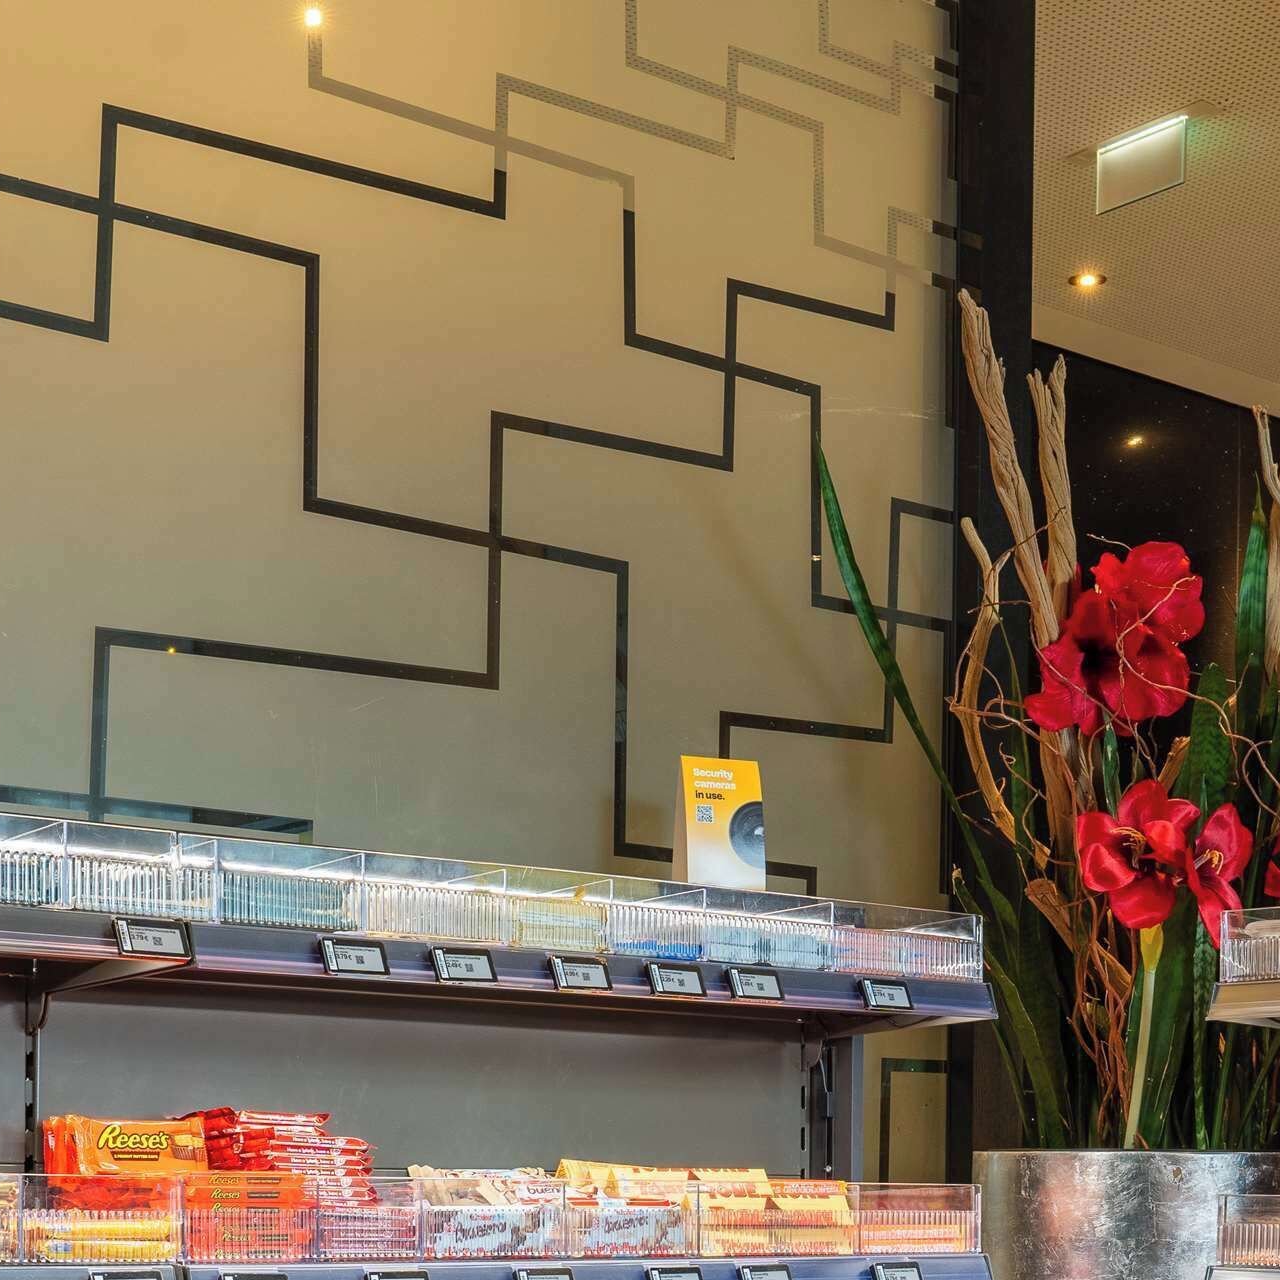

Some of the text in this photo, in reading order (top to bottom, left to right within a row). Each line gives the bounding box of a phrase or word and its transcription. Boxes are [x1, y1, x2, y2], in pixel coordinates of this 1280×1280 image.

[693, 768, 733, 780] Security
[695, 781, 736, 790] cameras
[695, 790, 704, 799] in
[97, 1124, 170, 1150] Reese's
